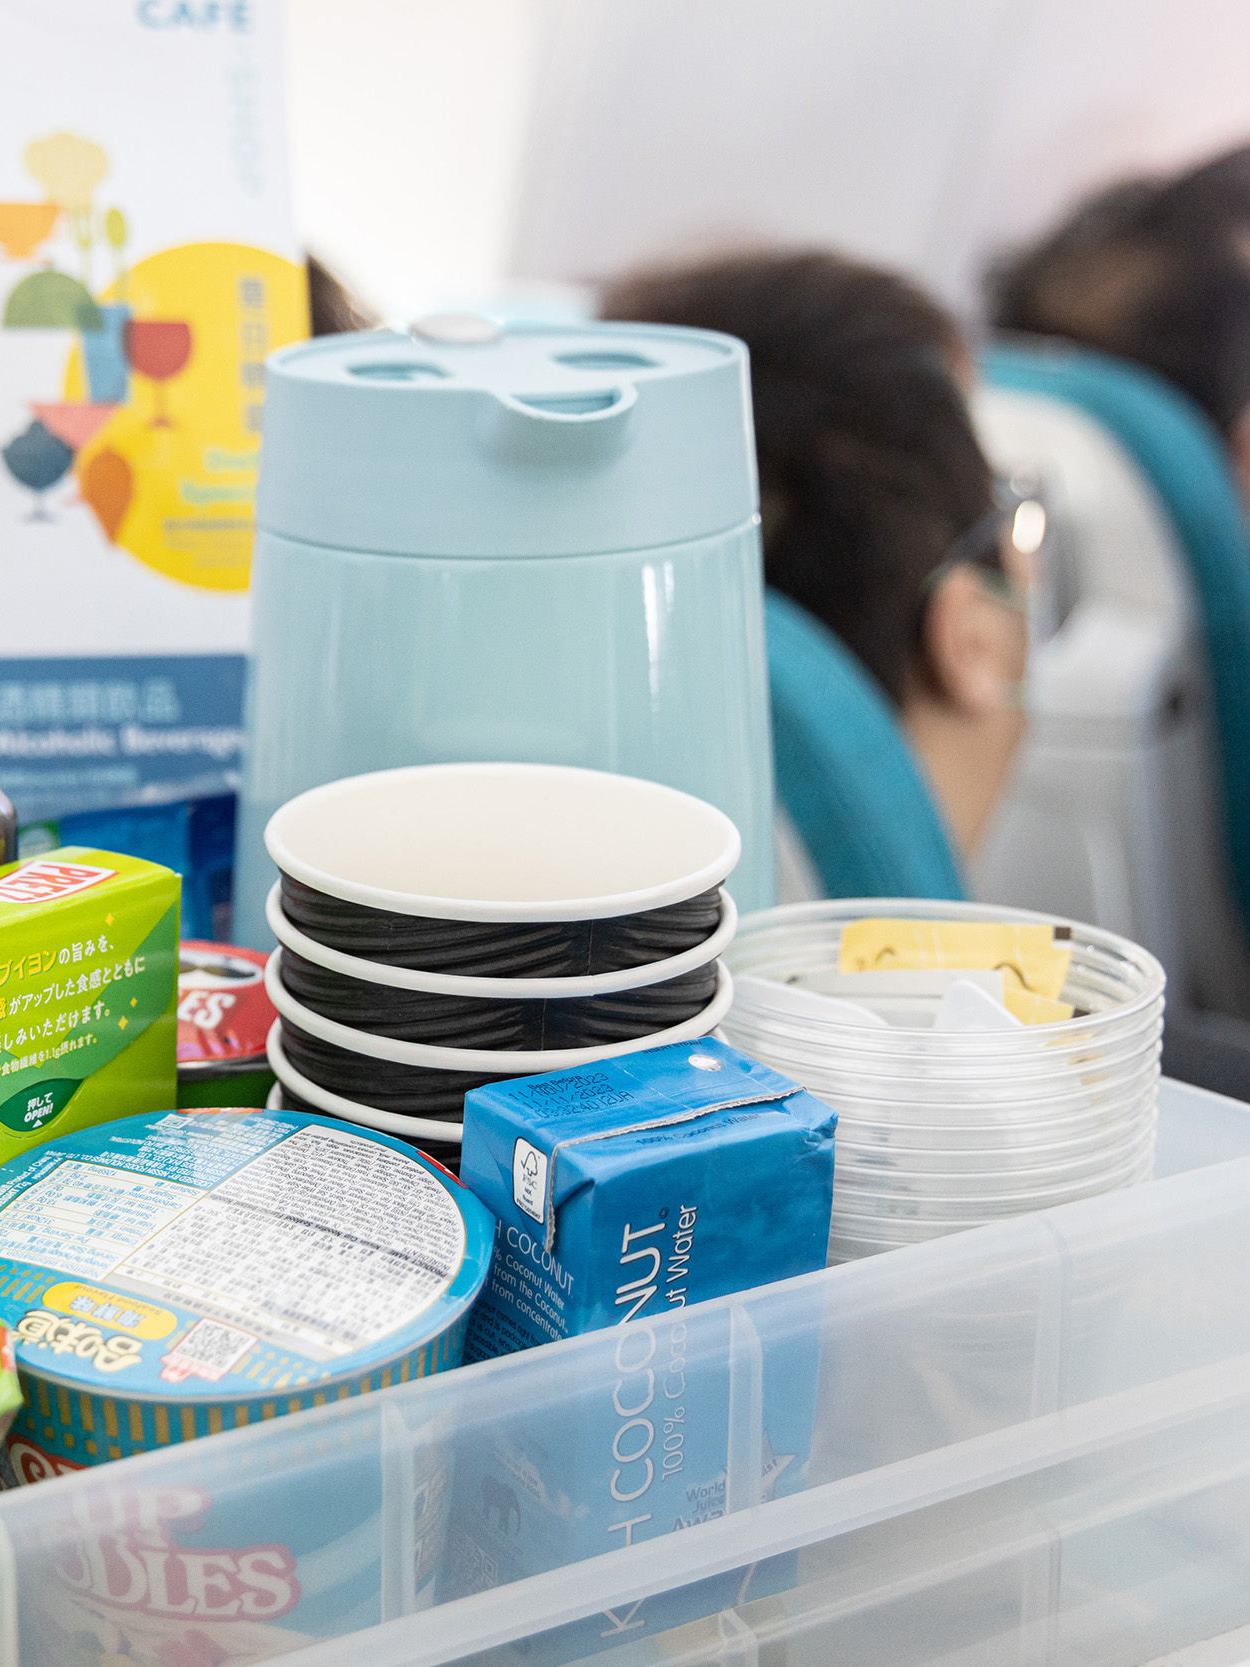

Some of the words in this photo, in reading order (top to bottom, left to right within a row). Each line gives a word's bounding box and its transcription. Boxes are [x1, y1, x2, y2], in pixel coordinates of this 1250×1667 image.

[177, 990, 237, 1030] ES
[528, 1080, 550, 1090] Best
[551, 1074, 582, 1085] Before
[27, 1092, 53, 1112] 押して
[522, 1084, 614, 1110] 11/11/2023
[24, 1103, 54, 1124] OPEN!
[673, 1122, 724, 1138] Coconut
[726, 1112, 761, 1126] Water
[89, 1155, 126, 1167] HOLDINGS
[120, 1162, 148, 1172] FOODS
[178, 1161, 206, 1170] FOODS
[143, 1167, 171, 1177] NISSIN
[174, 1167, 222, 1181] DISTRIBUTED
[176, 1175, 215, 1187] LICENSED
[522, 1174, 537, 1190] FSC
[145, 1188, 179, 1199] Sugars
[166, 1184, 202, 1195] Sodium
[122, 1199, 138, 1207] fat
[134, 1203, 161, 1212] Trans
[110, 1205, 154, 1219] Saturated
[132, 1219, 159, 1229] Total
[280, 1214, 316, 1227] Seafood
[38, 1227, 76, 1239] Serving
[115, 1225, 150, 1237] Protein
[309, 1223, 345, 1236] Noodles
[70, 1235, 91, 1243] Per
[105, 1232, 141, 1245] Energy
[668, 1205, 698, 1281] Water
[3, 1250, 60, 1266] Information
[82, 1249, 121, 1262] Serving
[507, 1227, 574, 1295] COCONUT
[55, 1262, 105, 1277] Nutrition
[494, 1263, 517, 1288] from
[519, 1280, 532, 1299] the
[506, 1255, 542, 1288] Coconut
[544, 1281, 565, 1310] Water
[73, 1283, 116, 1302] Flavour
[492, 1280, 513, 1303] from
[69, 1295, 146, 1328] 海鮮味
[480, 1310, 492, 1325] and
[494, 1318, 500, 1329] is
[497, 1310, 516, 1326] comes
[518, 1321, 529, 1338] right
[11, 1309, 142, 1372] 合味道
[610, 1221, 667, 1503] COCONUT
[661, 1407, 686, 1482] 100%
[685, 1481, 726, 1503] World
[600, 1514, 652, 1638] KH
